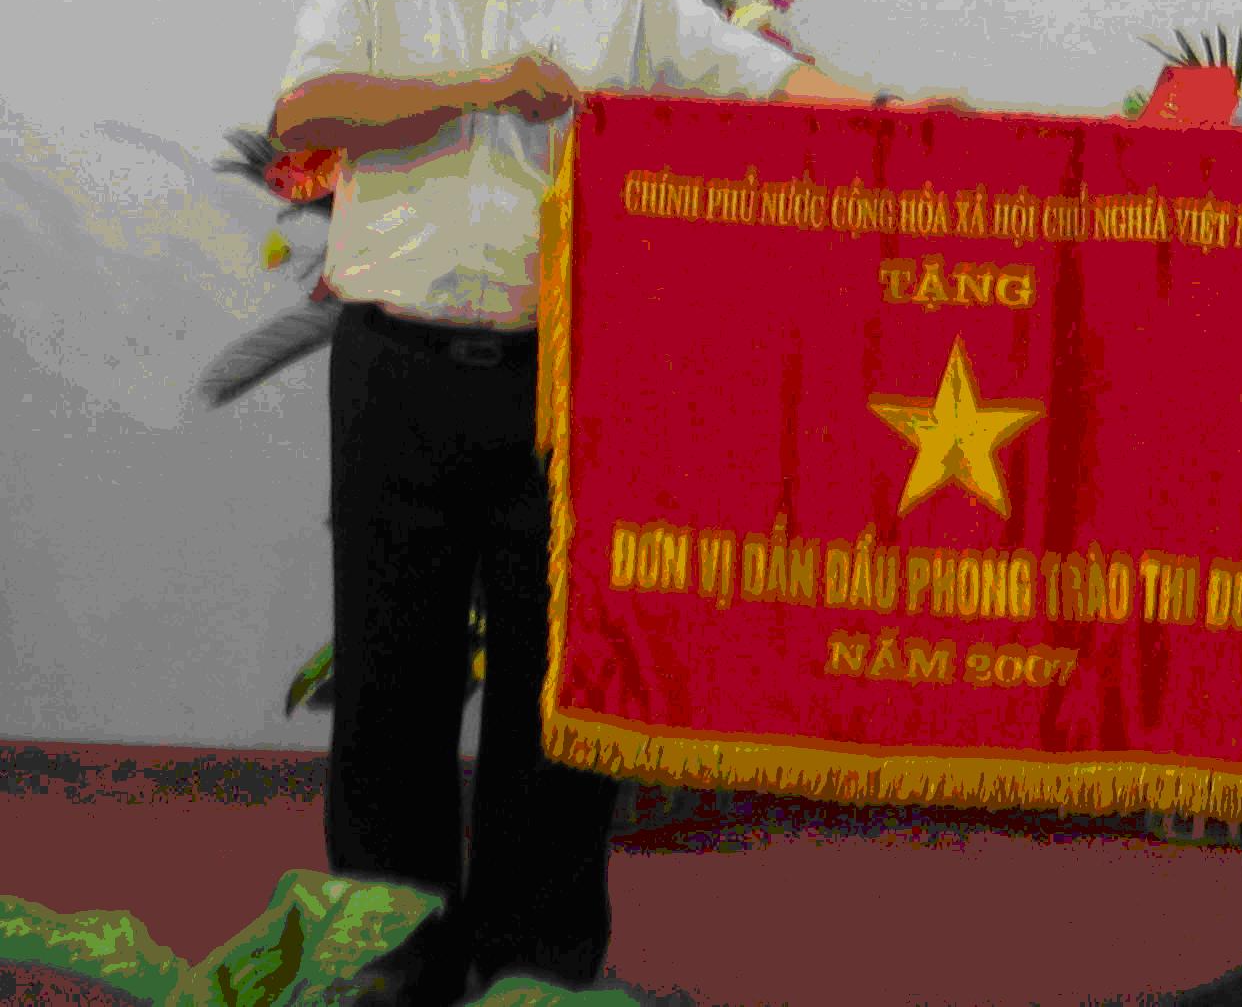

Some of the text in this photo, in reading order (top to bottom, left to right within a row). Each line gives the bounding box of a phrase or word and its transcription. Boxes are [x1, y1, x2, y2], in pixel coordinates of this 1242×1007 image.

[624, 172, 702, 218] CHÍNH
[831, 185, 898, 237] CỘNG
[901, 186, 949, 236] HÒA
[993, 192, 1038, 247] HỘI
[1174, 197, 1231, 253] VIỆT
[880, 259, 1035, 309] TẶNG
[611, 526, 692, 591] ĐƠN
[699, 532, 734, 608] VỊ
[905, 552, 1032, 614] PHONG
[1139, 559, 1198, 621] THI
[964, 649, 1077, 684] 2007
